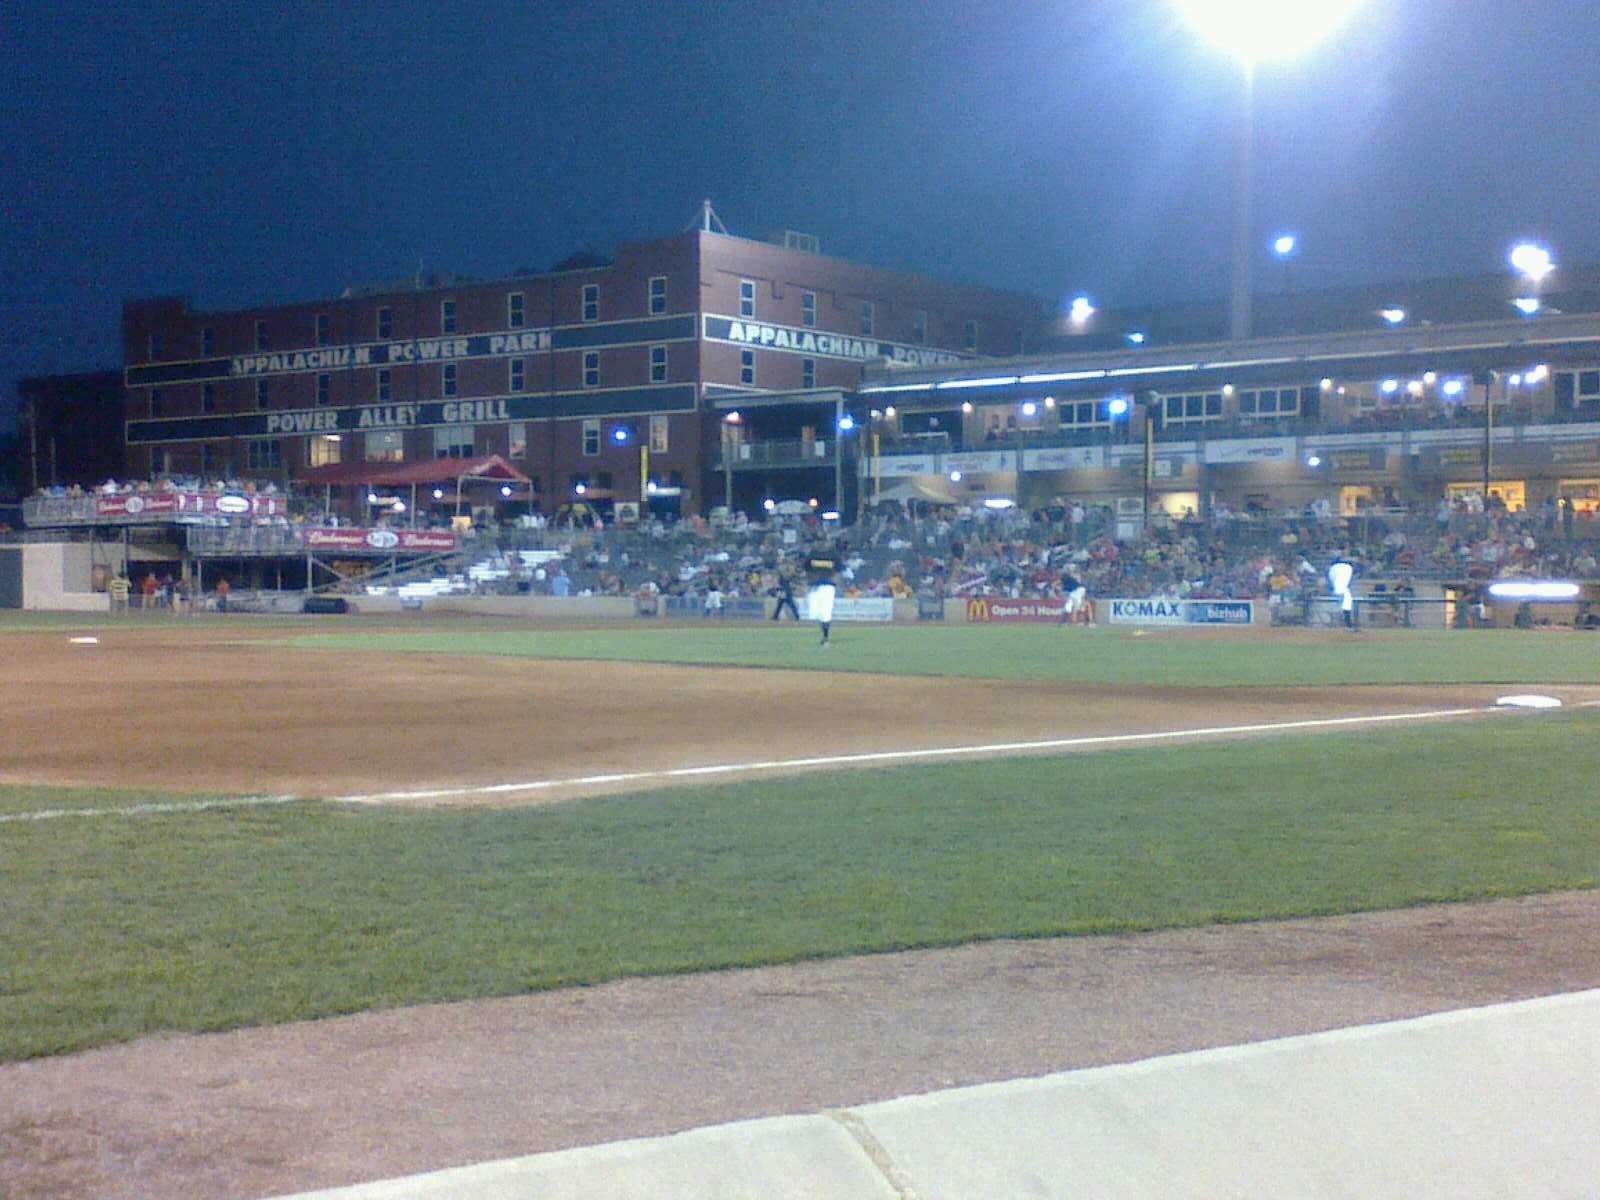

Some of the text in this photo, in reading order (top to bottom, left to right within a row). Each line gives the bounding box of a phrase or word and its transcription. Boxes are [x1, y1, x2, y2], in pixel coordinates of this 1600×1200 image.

[728, 321, 879, 359] APPALACHIAN
[231, 332, 551, 374] APPALACHIAN POWER PARK
[266, 400, 510, 433] POWER ALLEY GRILL
[991, 604, 1020, 617] Open
[1111, 601, 1181, 617] KOMAX
[1206, 606, 1248, 619] bizhub
